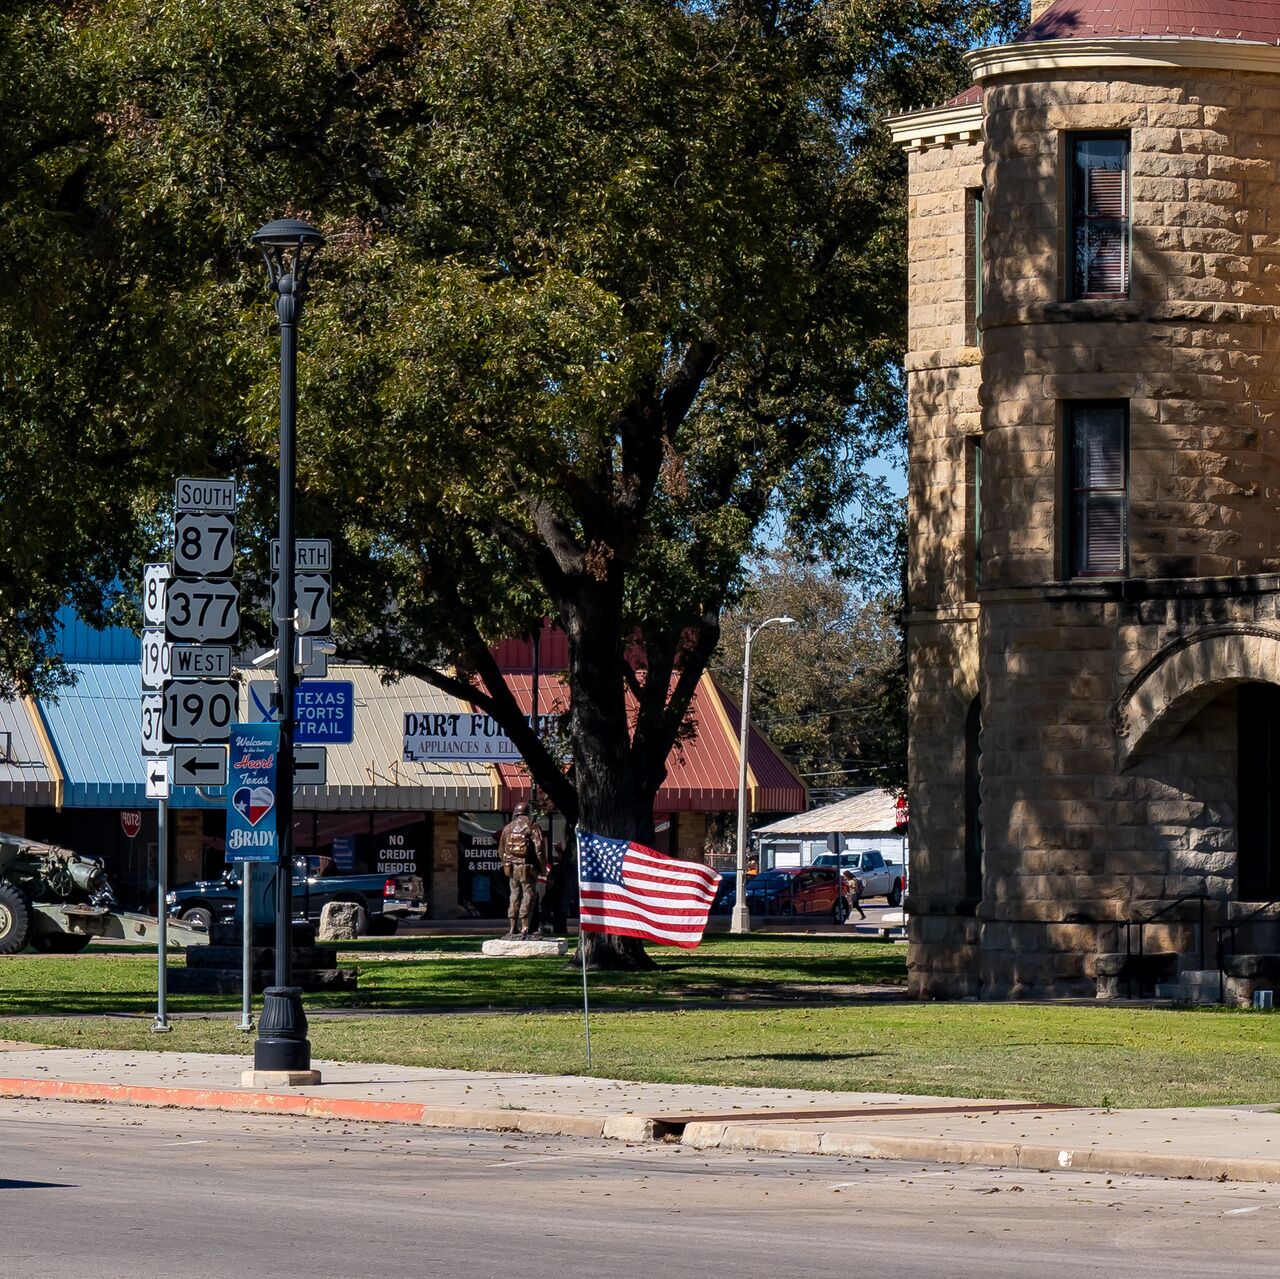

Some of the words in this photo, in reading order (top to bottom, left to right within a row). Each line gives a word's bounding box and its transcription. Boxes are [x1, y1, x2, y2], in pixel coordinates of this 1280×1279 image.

[180, 484, 232, 506] SOUTH
[181, 526, 229, 561] 87
[275, 545, 327, 565] RTH
[170, 592, 236, 628] 377
[144, 642, 170, 676] 190
[178, 651, 225, 672] WEST
[296, 692, 345, 705] TEXAS
[169, 693, 231, 728] 190
[297, 707, 345, 719] FORTS
[143, 707, 162, 741] 37
[299, 722, 344, 734] TRAIL
[404, 714, 460, 737] DART
[235, 736, 273, 746] Welcome
[418, 740, 480, 754] APPLIANCES
[485, 741, 492, 754] &
[234, 753, 274, 769] Heart
[240, 772, 269, 785] Texas
[229, 829, 276, 849] BRADY
[389, 835, 404, 846] NO
[472, 836, 493, 846] FREE
[379, 849, 416, 860] CREDIT
[377, 862, 417, 873] NEEDED
[469, 861, 476, 870] &
[477, 861, 504, 870] SETUP
